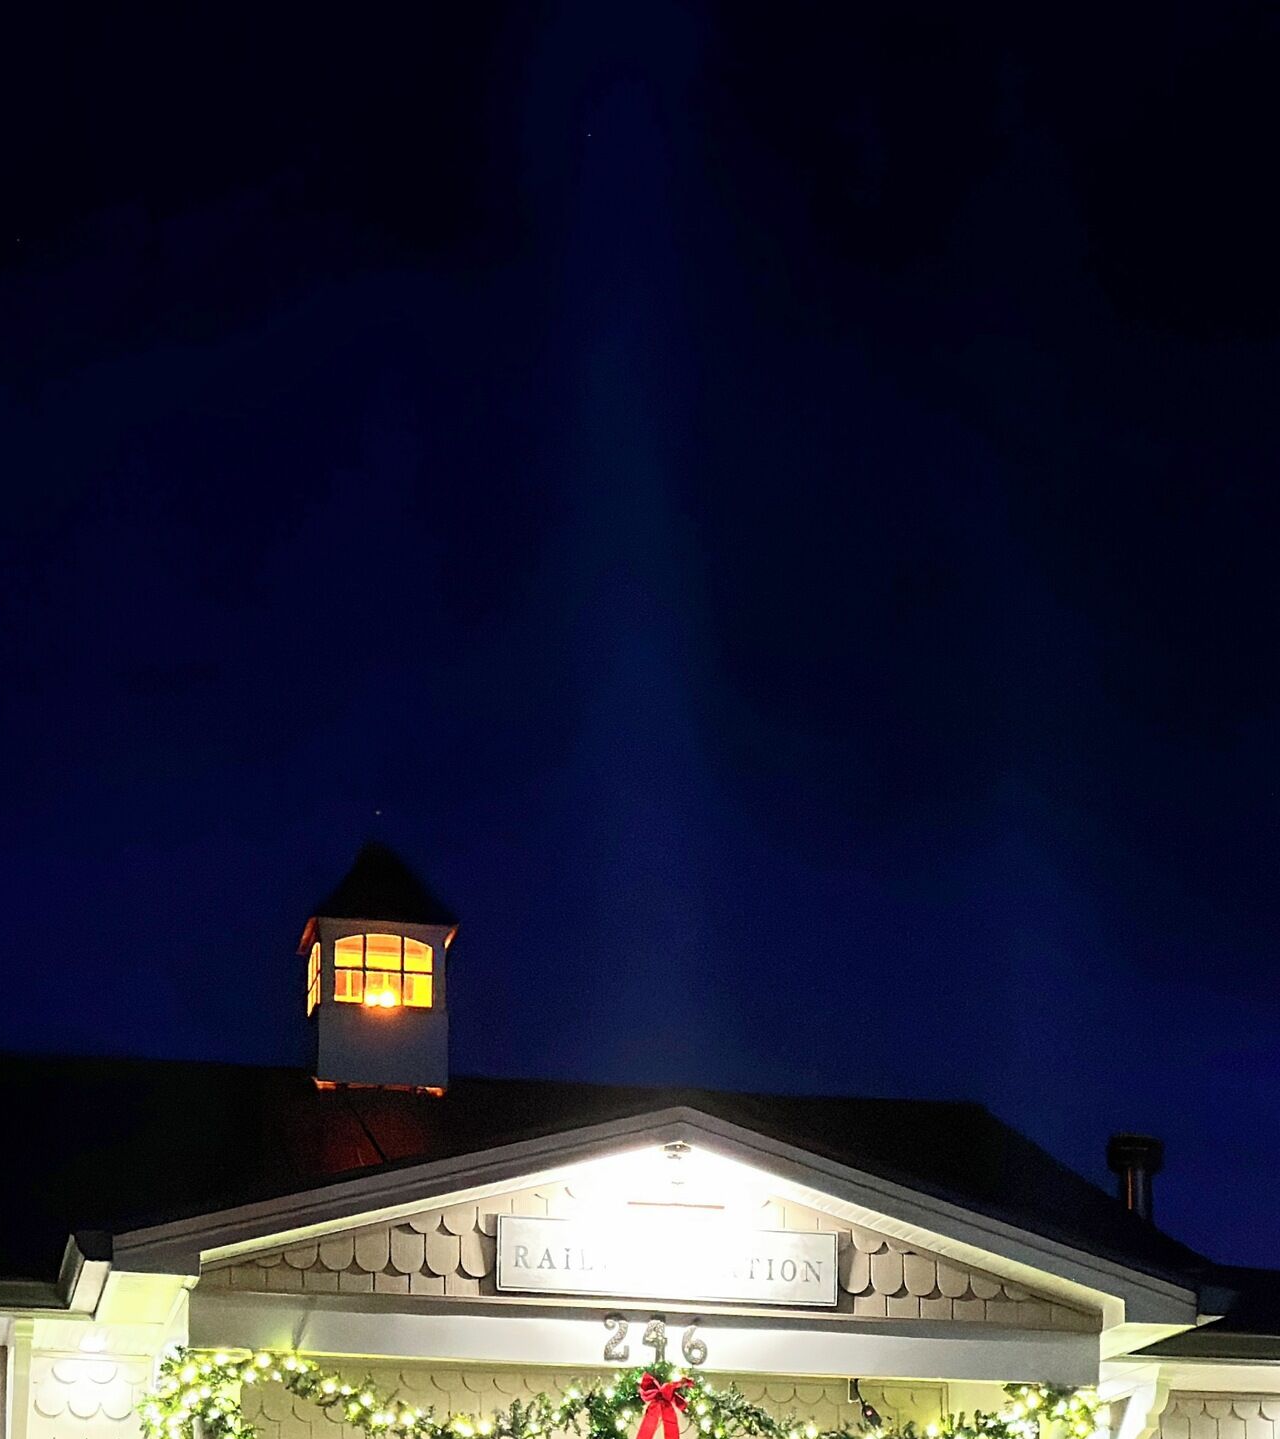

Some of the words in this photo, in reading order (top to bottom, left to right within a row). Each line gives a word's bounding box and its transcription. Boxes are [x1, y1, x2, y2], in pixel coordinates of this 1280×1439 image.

[513, 1245, 606, 1272] RAIL
[723, 1257, 824, 1284] TION
[603, 1319, 708, 1366] 246
